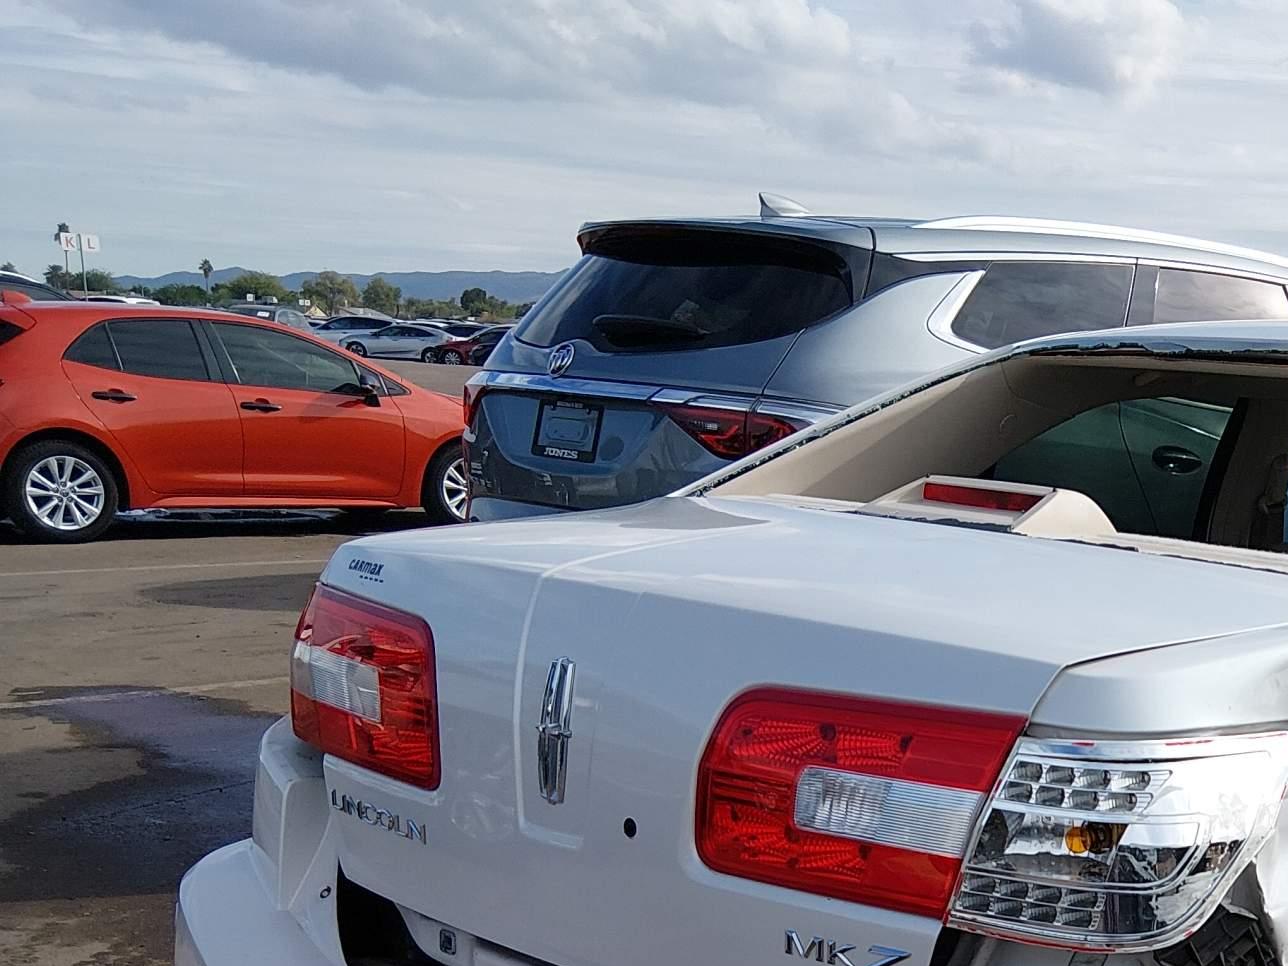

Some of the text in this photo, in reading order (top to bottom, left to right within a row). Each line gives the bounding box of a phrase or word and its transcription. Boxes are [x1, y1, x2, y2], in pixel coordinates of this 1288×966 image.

[64, 235, 76, 249] K
[87, 237, 97, 250] L
[544, 446, 579, 459] JONES
[331, 789, 428, 846] LINCOLN
